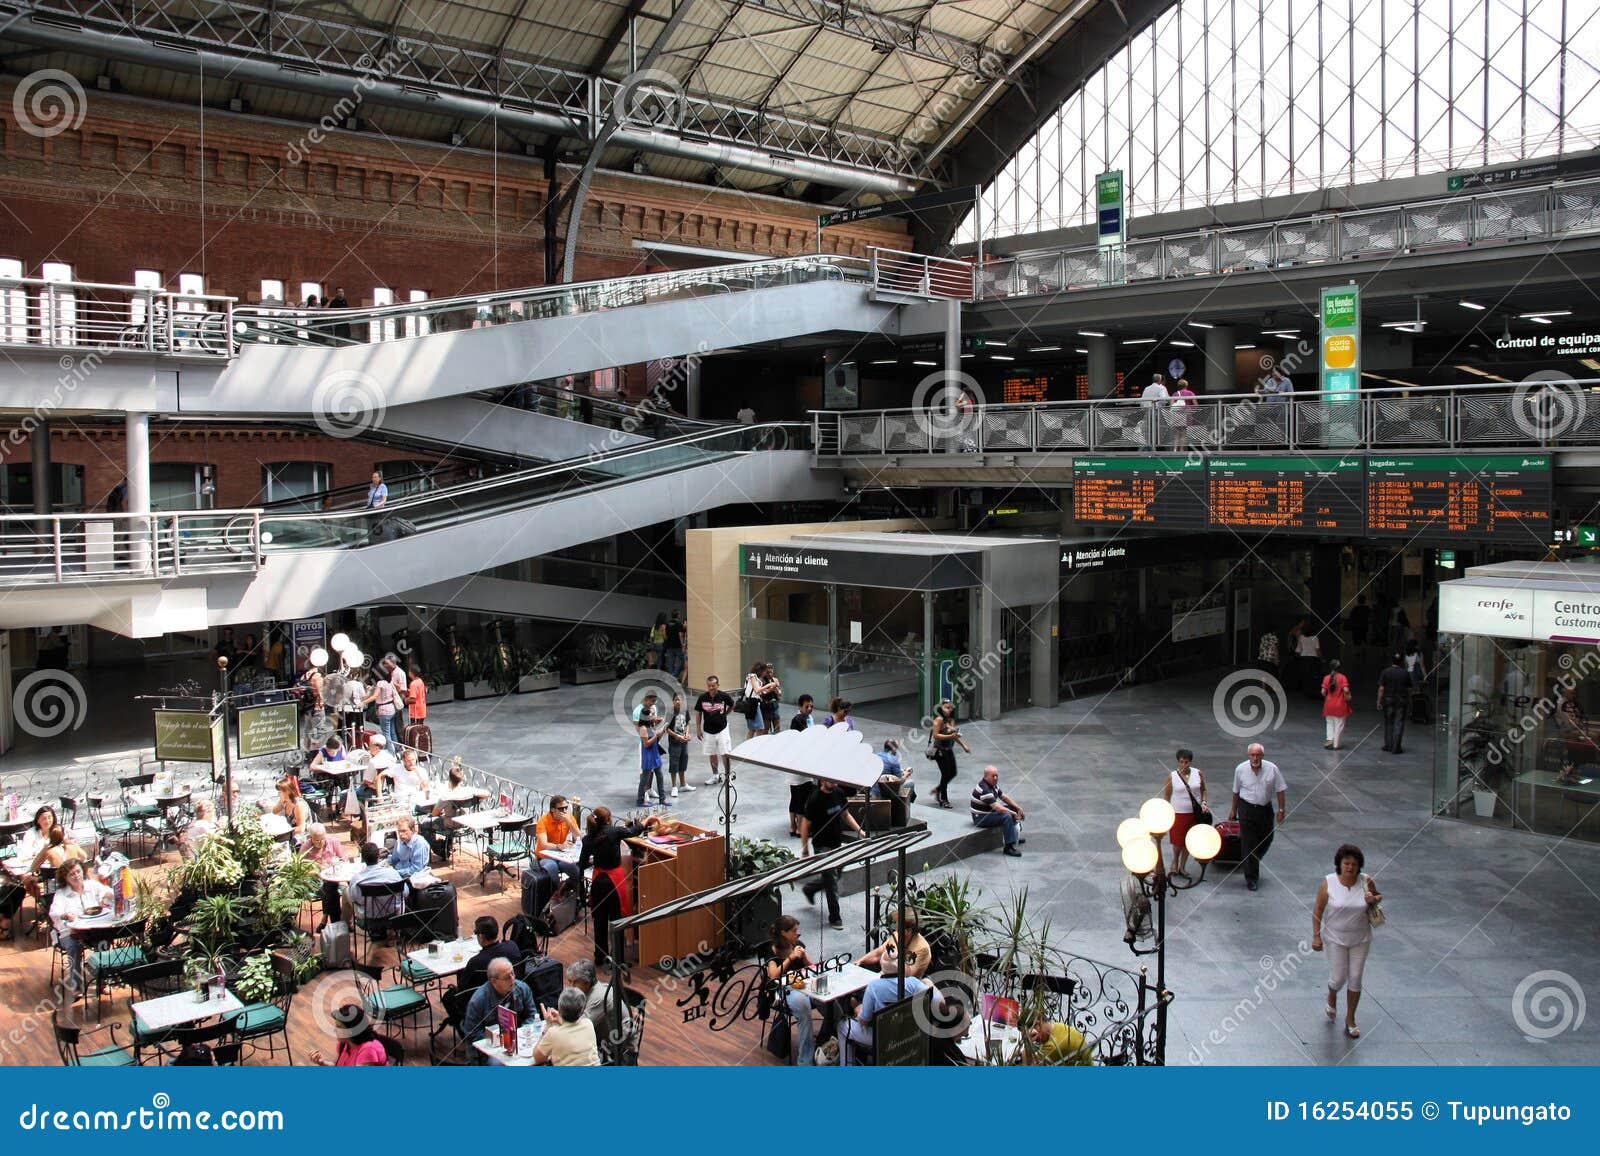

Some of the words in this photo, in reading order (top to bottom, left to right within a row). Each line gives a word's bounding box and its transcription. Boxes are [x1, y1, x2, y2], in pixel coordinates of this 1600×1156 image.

[1496, 336, 1536, 348] Control
[1540, 336, 1556, 346] de
[1557, 346, 1587, 354] LUGGAGE
[1369, 460, 1395, 468] Llegadas
[1076, 549, 1100, 560] Atención
[1101, 548, 1106, 558] al
[1107, 547, 1126, 556] cliente
[765, 554, 794, 564] Atención
[796, 555, 802, 564] al
[804, 556, 829, 566] cliente
[1478, 599, 1514, 612] renfe
[1554, 600, 1600, 616] Centro
[1504, 612, 1525, 620] AVE
[296, 622, 323, 632] FOTOS
[682, 1005, 706, 1024] EL
